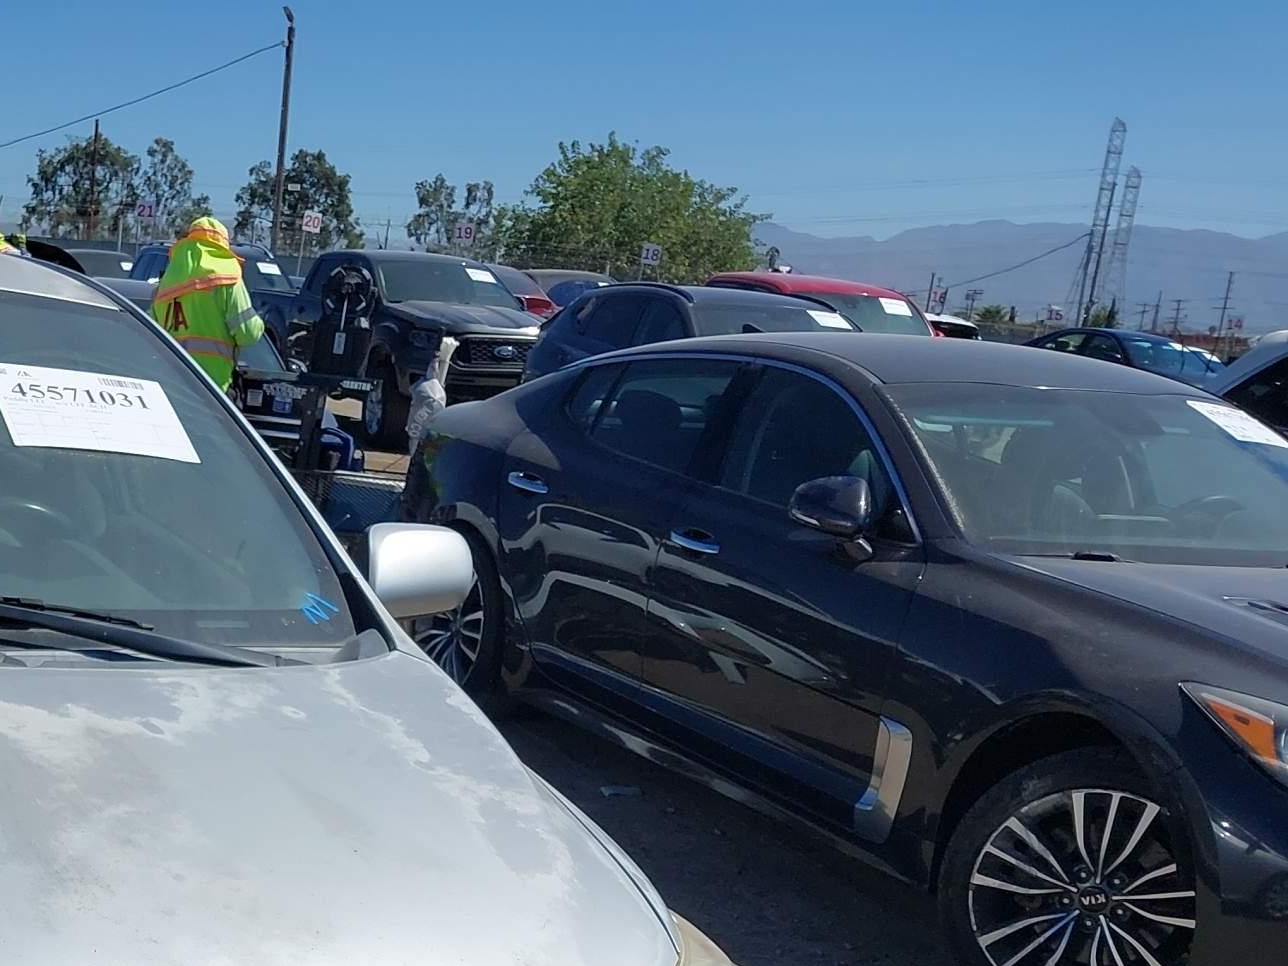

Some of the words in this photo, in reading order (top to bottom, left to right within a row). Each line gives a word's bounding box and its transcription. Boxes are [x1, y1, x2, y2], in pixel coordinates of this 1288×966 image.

[136, 203, 154, 218] 21
[304, 214, 321, 229] 20
[455, 226, 473, 240] 19
[644, 247, 661, 262] 18
[11, 382, 152, 410] 45571031
